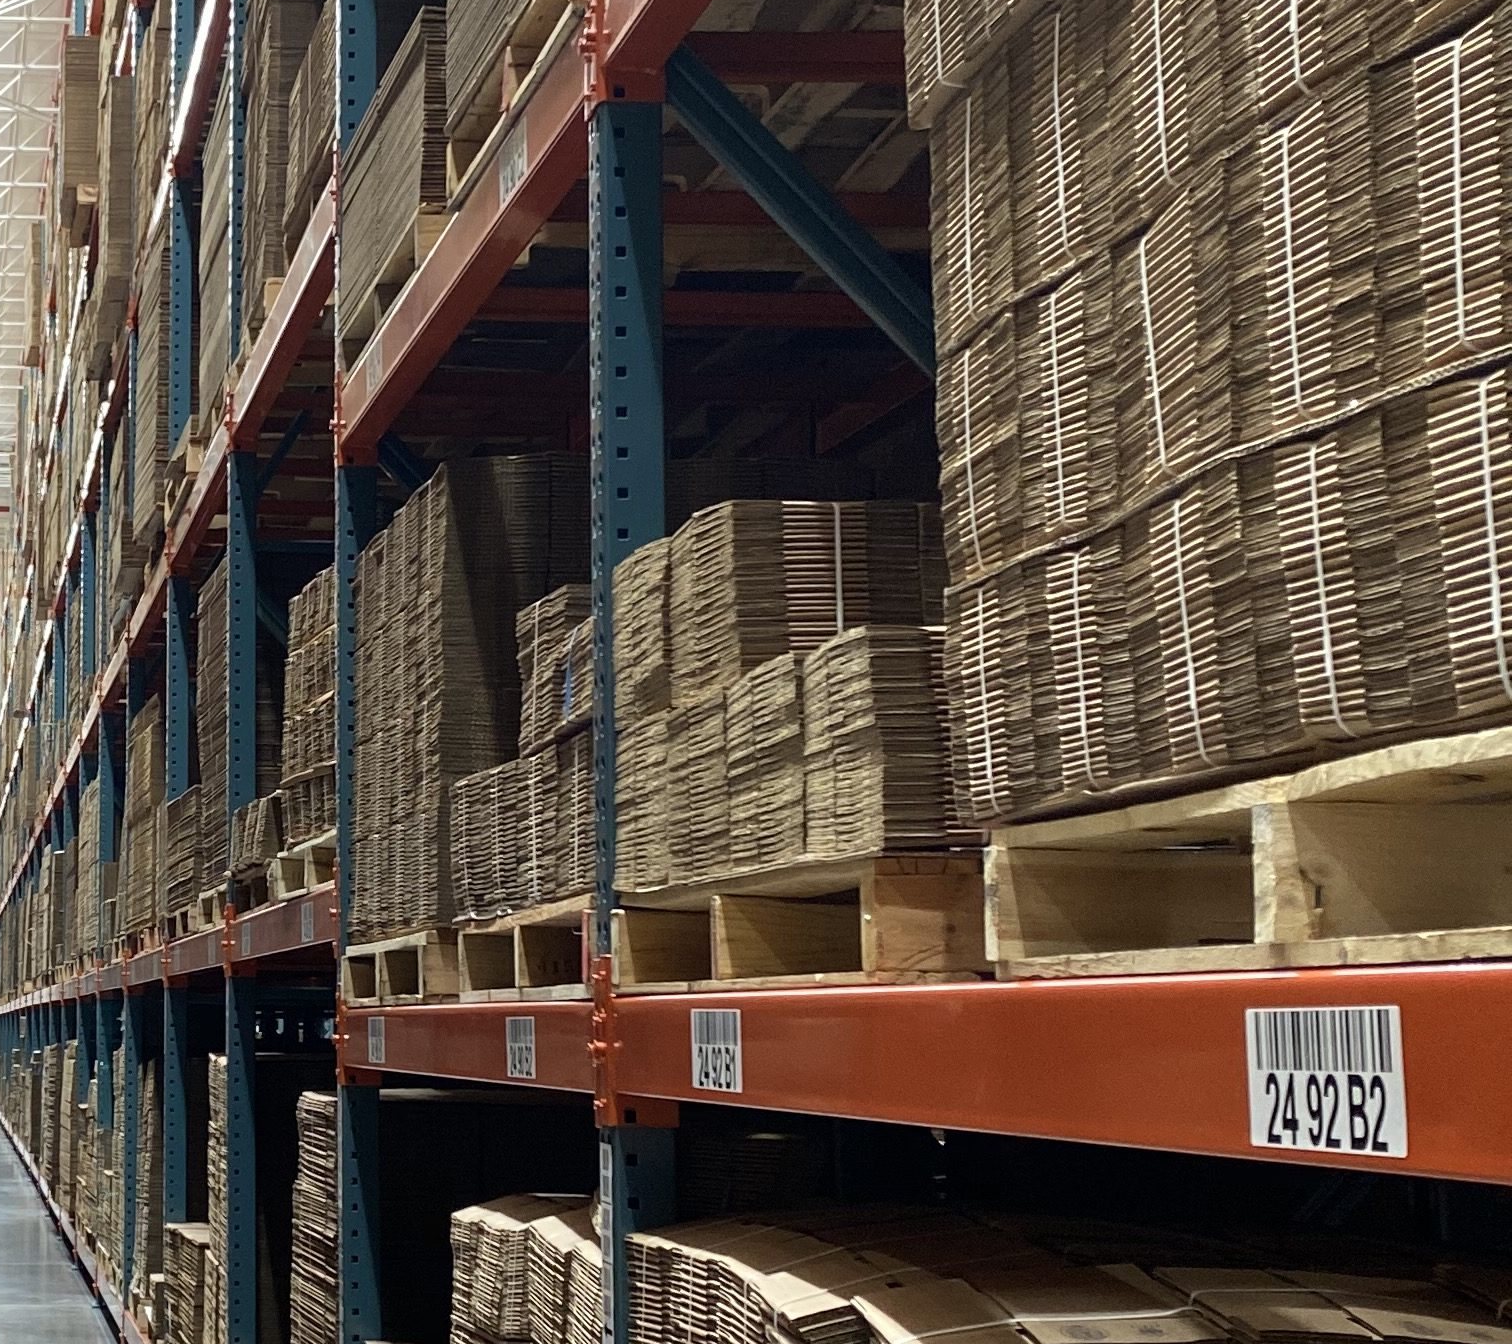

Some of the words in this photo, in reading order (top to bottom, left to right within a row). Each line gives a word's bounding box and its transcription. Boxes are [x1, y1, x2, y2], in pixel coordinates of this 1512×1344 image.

[510, 1045, 517, 1076] 24
[525, 1045, 533, 1077] B2
[698, 1045, 710, 1088] 24
[712, 1046, 724, 1089] 92
[724, 1046, 737, 1091] B1
[1266, 1072, 1299, 1146] 24
[1307, 1073, 1341, 1149] 92
[1347, 1074, 1388, 1153] B2
